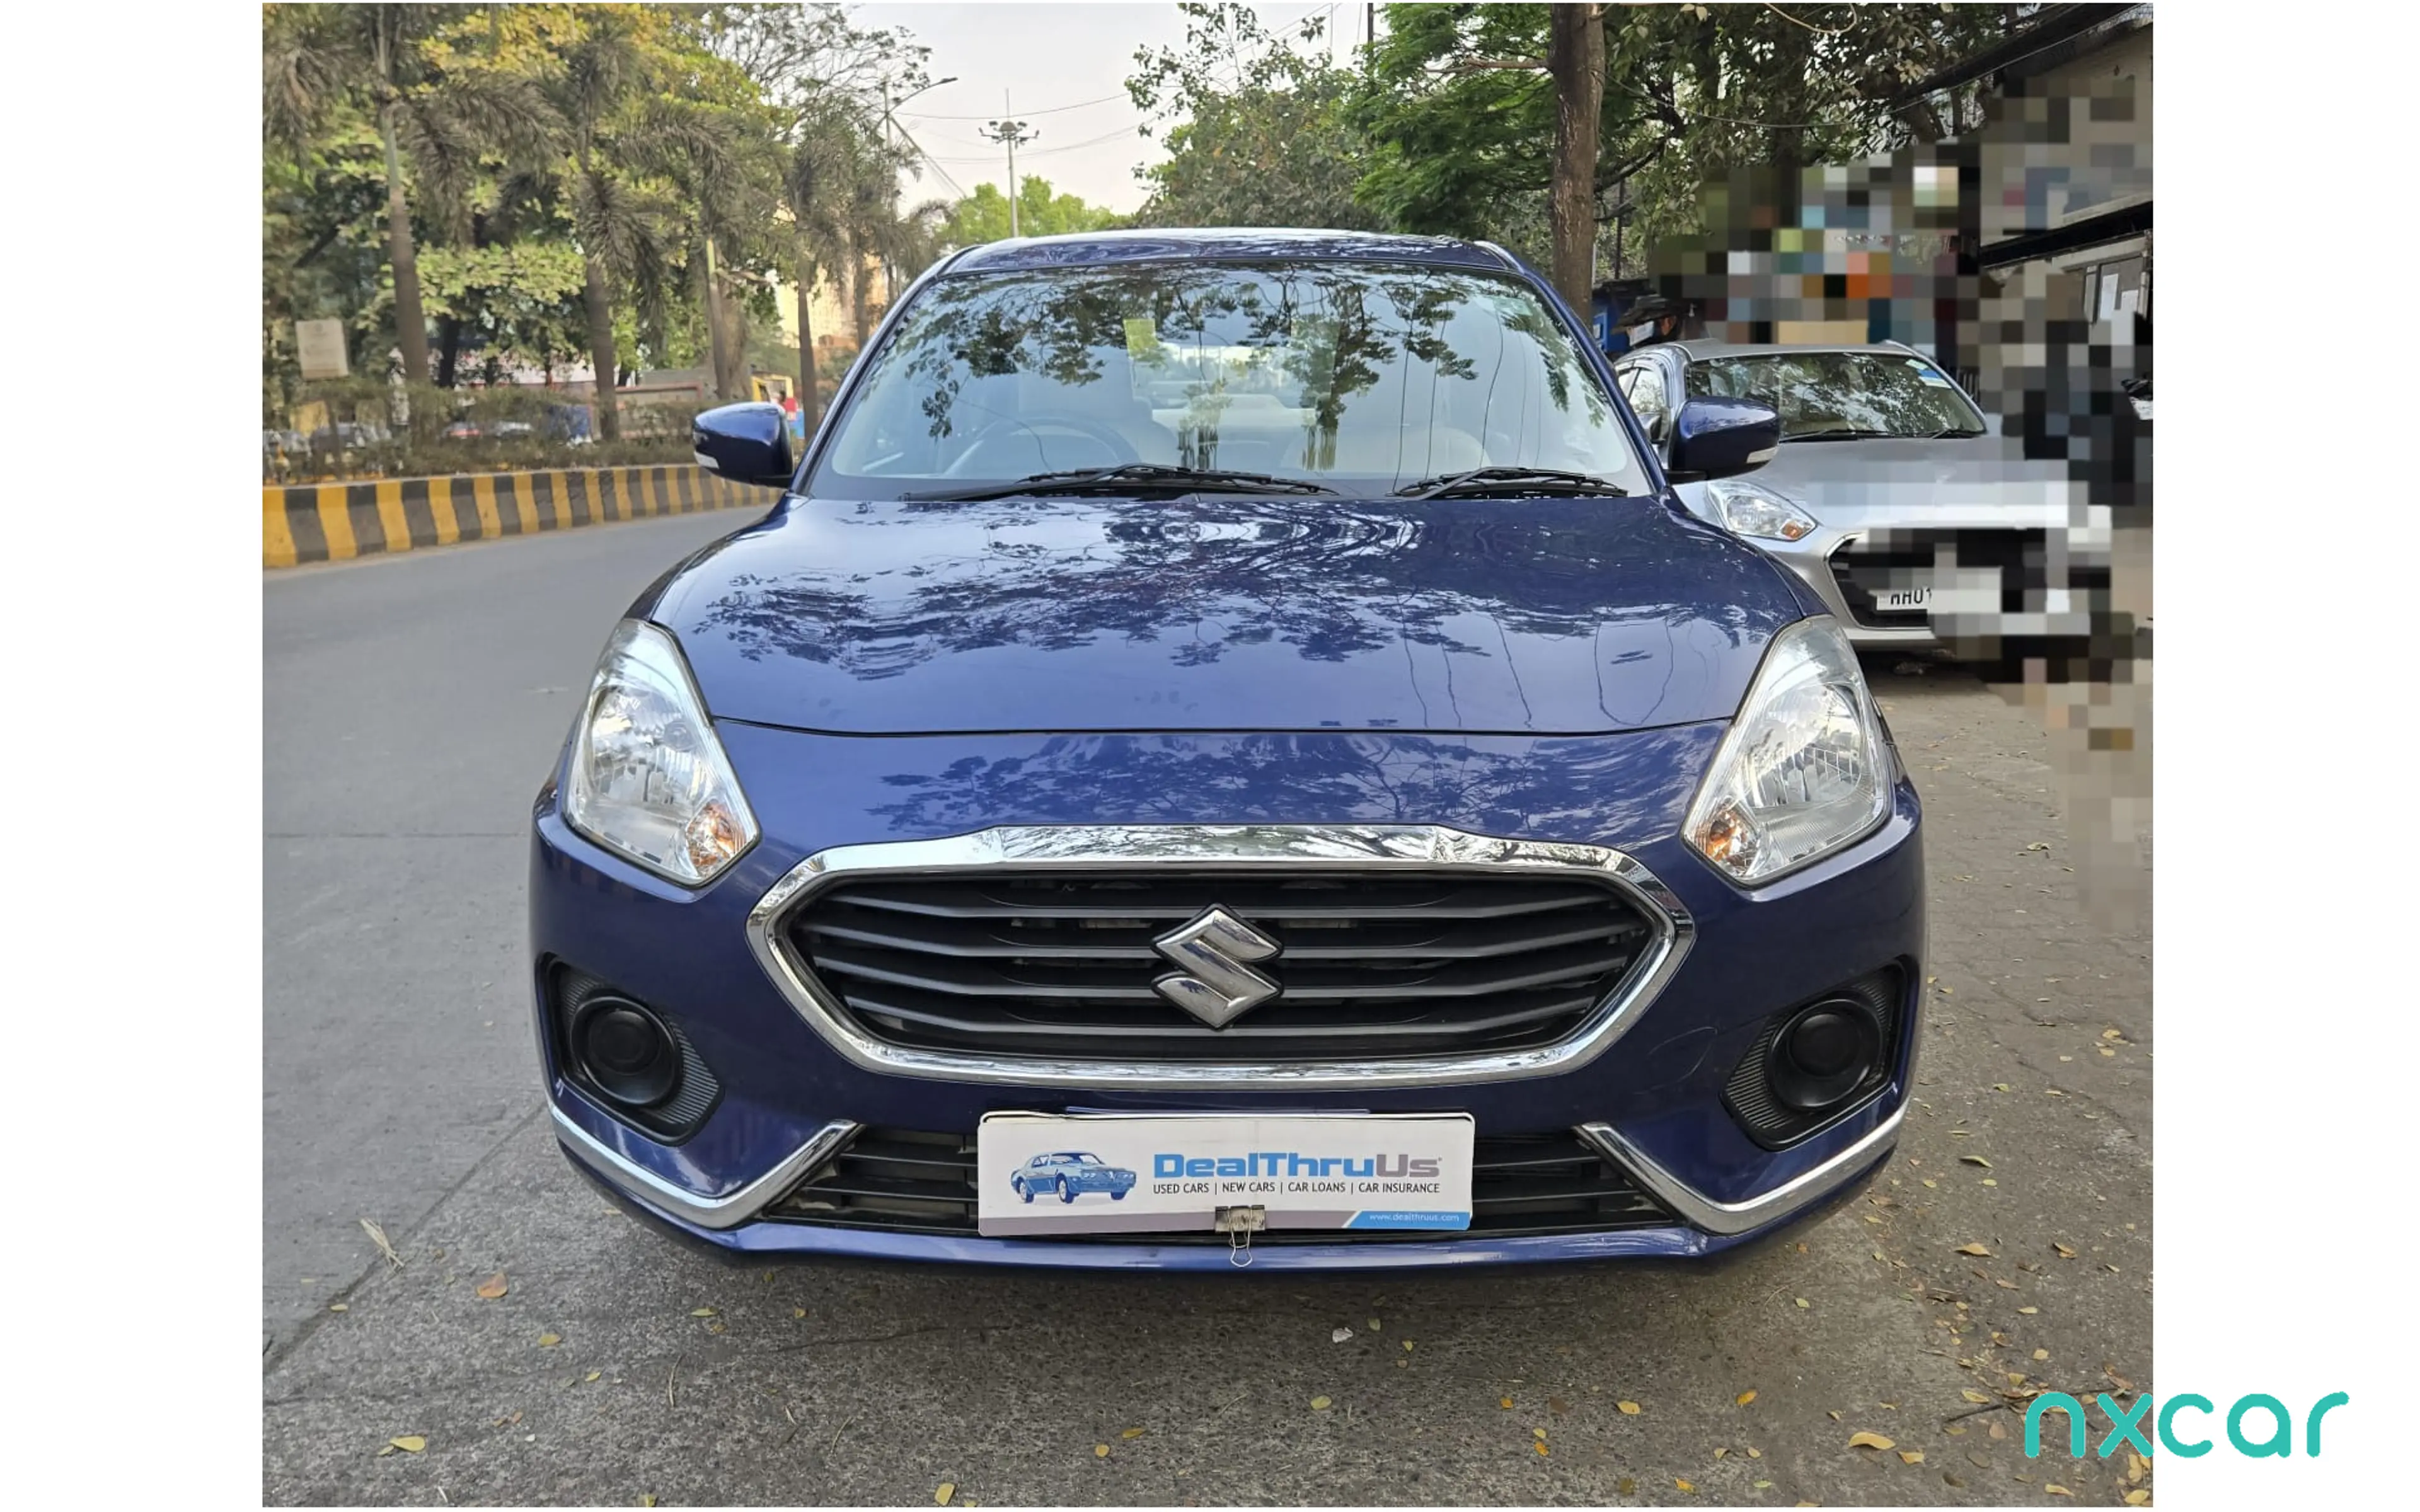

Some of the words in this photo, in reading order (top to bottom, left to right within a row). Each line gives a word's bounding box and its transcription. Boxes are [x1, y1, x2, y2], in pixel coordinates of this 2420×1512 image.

[1154, 1152, 1440, 1178] DealThruUs
[1153, 1184, 1180, 1194] USED
[1184, 1183, 1209, 1193] CARS
[1222, 1182, 1246, 1193] NEW
[1248, 1181, 1276, 1193] CARS
[1288, 1181, 1309, 1193] CAR
[1311, 1182, 1346, 1193] LOANS
[1358, 1183, 1380, 1193] CAR
[1382, 1183, 1440, 1193] INSURANCE
[1369, 1212, 1460, 1222] www.dealthruus.com
